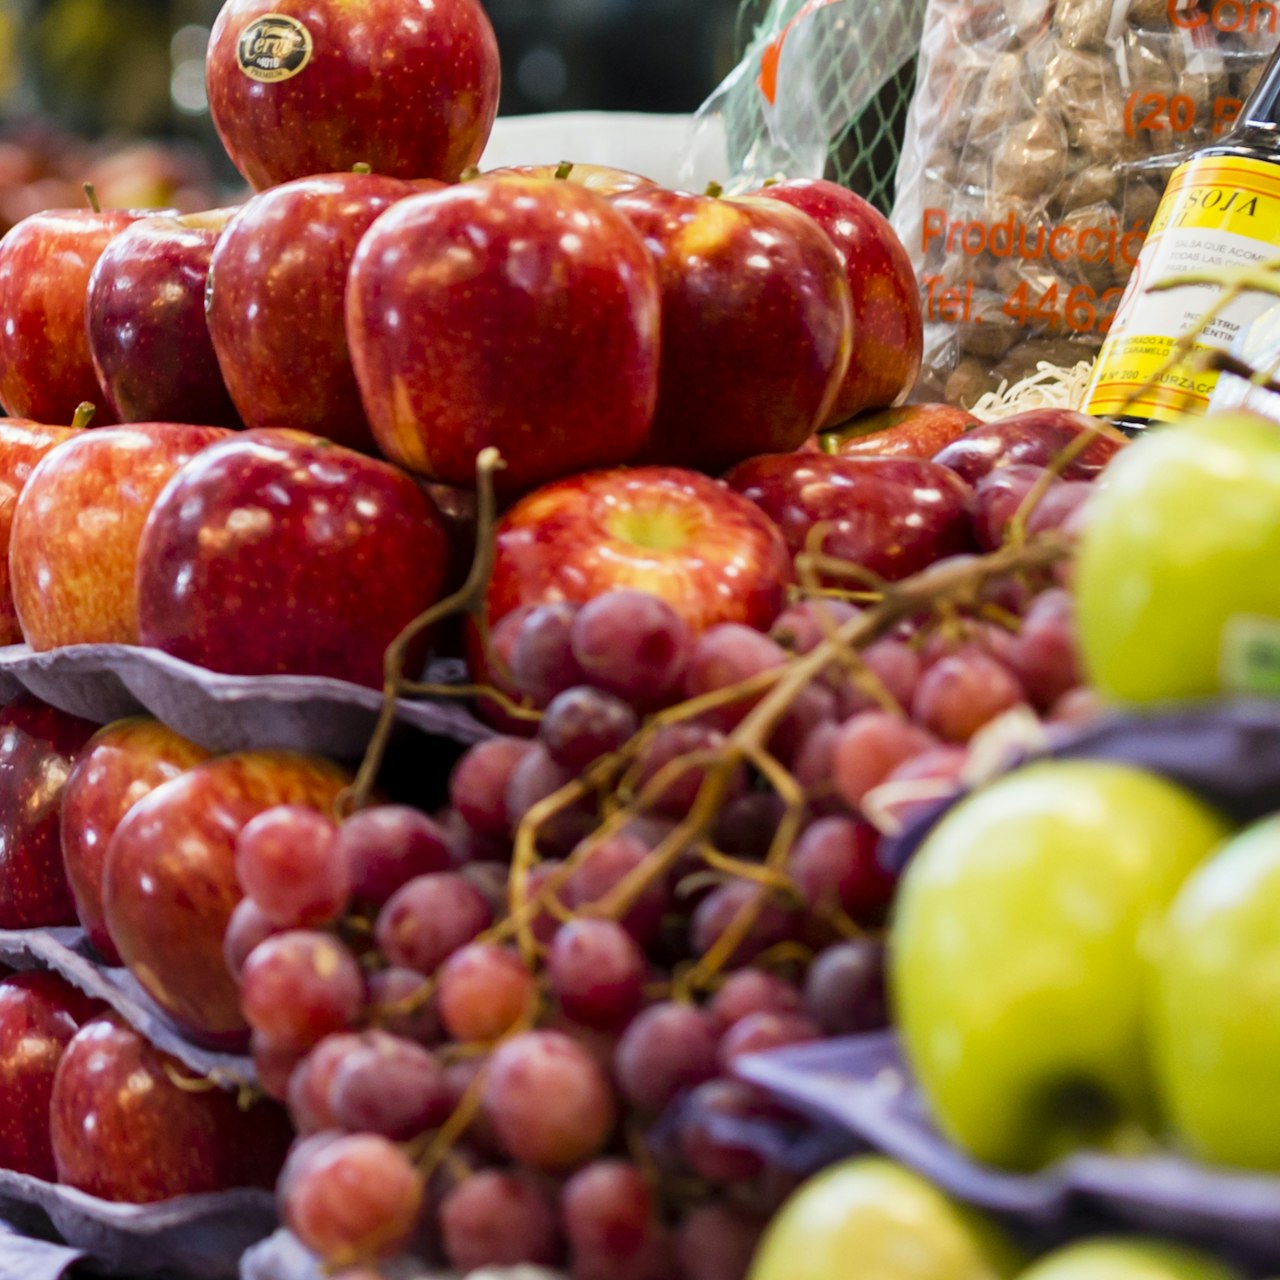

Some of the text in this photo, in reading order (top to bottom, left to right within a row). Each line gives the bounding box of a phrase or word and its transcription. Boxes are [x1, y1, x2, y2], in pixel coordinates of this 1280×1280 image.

[1123, 90, 1195, 141] (20
[1184, 189, 1260, 218] SOJA
[1203, 240, 1226, 254] QUE
[922, 275, 984, 326] Tel.
[1120, 369, 1140, 380] 200
